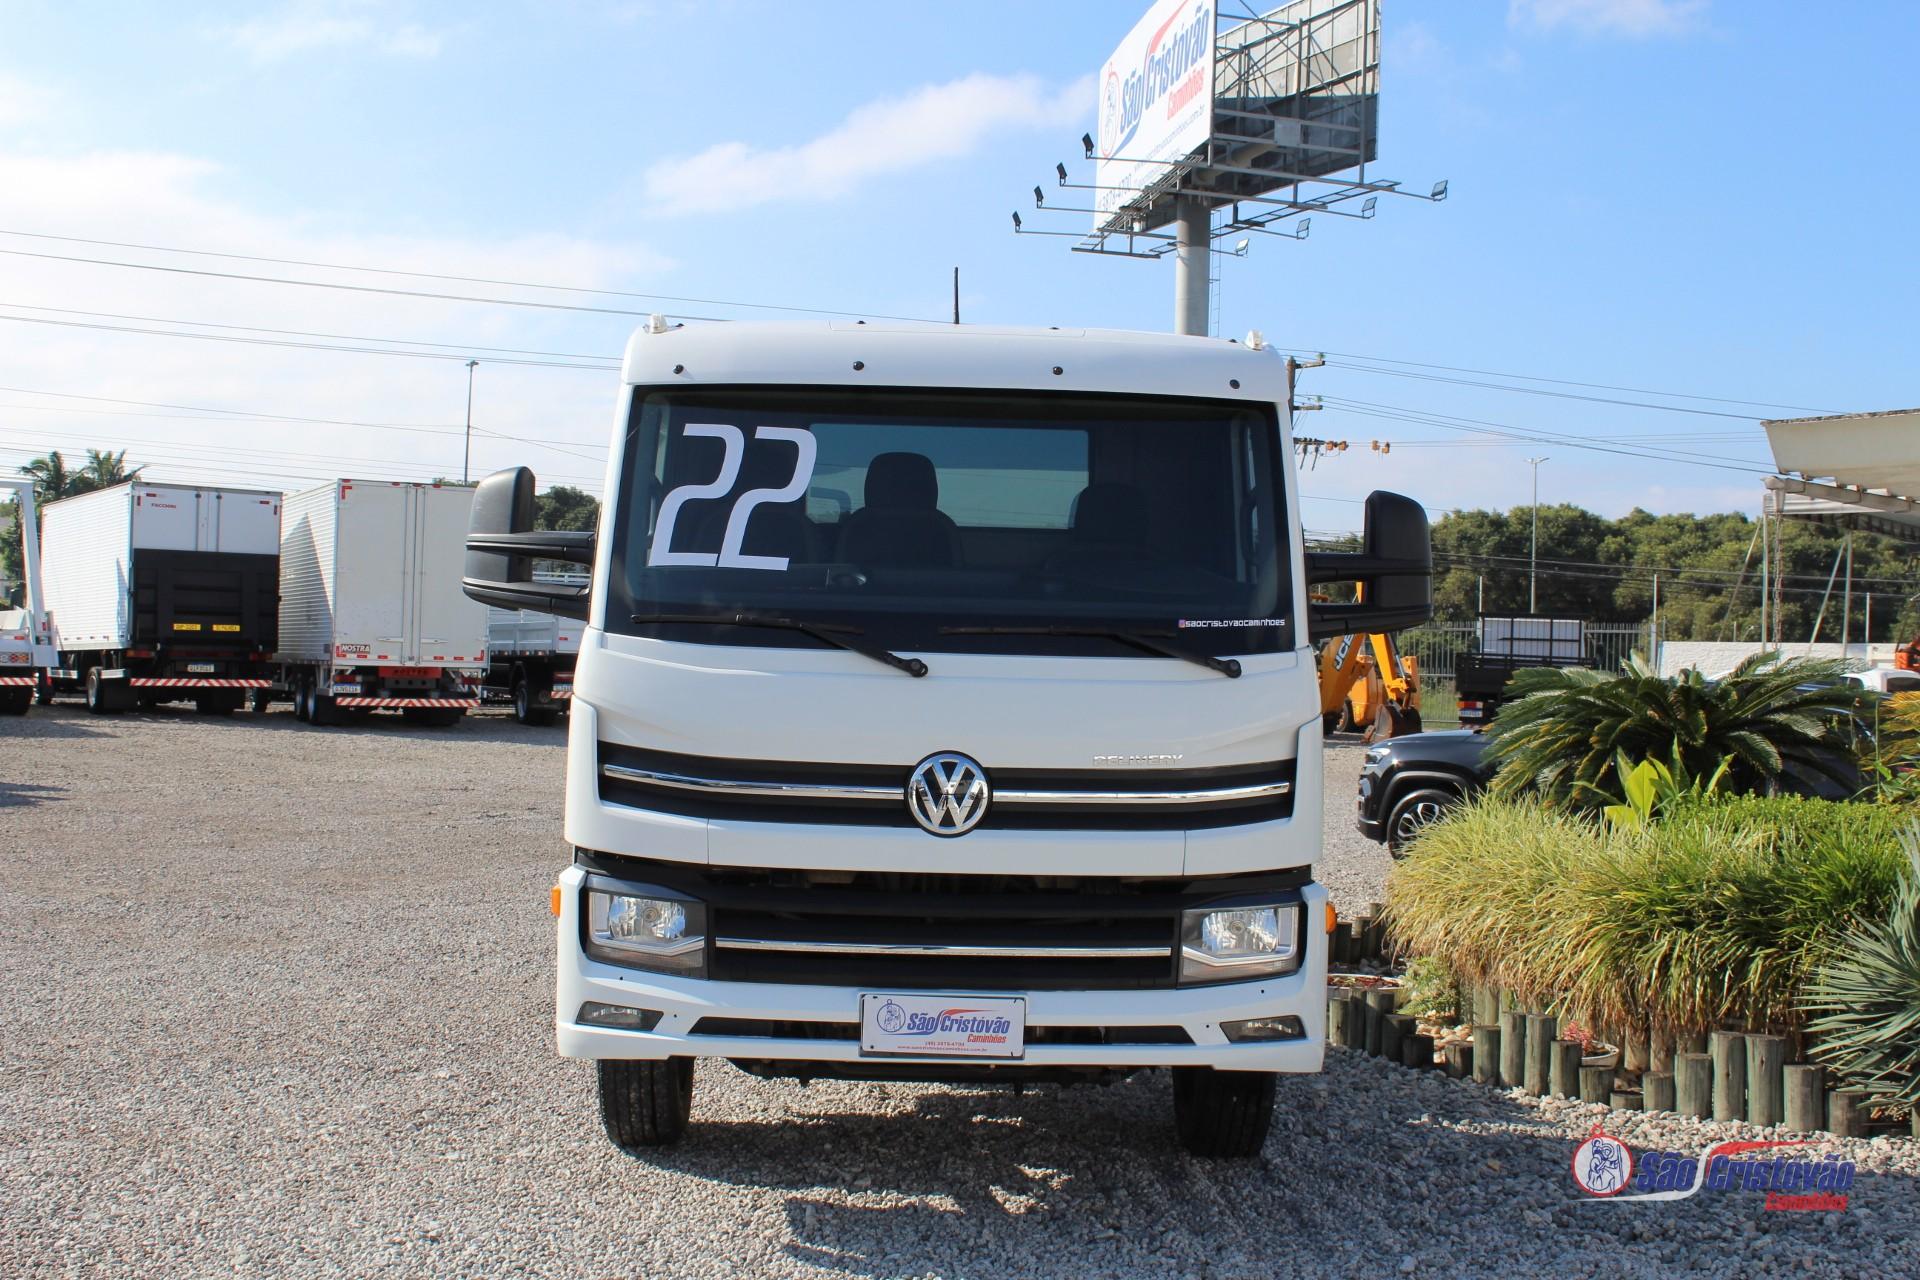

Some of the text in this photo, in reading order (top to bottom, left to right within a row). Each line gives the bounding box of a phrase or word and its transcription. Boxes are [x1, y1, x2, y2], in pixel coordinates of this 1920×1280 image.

[1120, 2, 1209, 134] São Cristóvão
[648, 423, 817, 571] 22
[341, 644, 370, 653] NOSTRA
[1333, 634, 1354, 669] JCB
[907, 1012, 1011, 1034] São Cristóvão
[967, 1033, 1007, 1044] Caminhões
